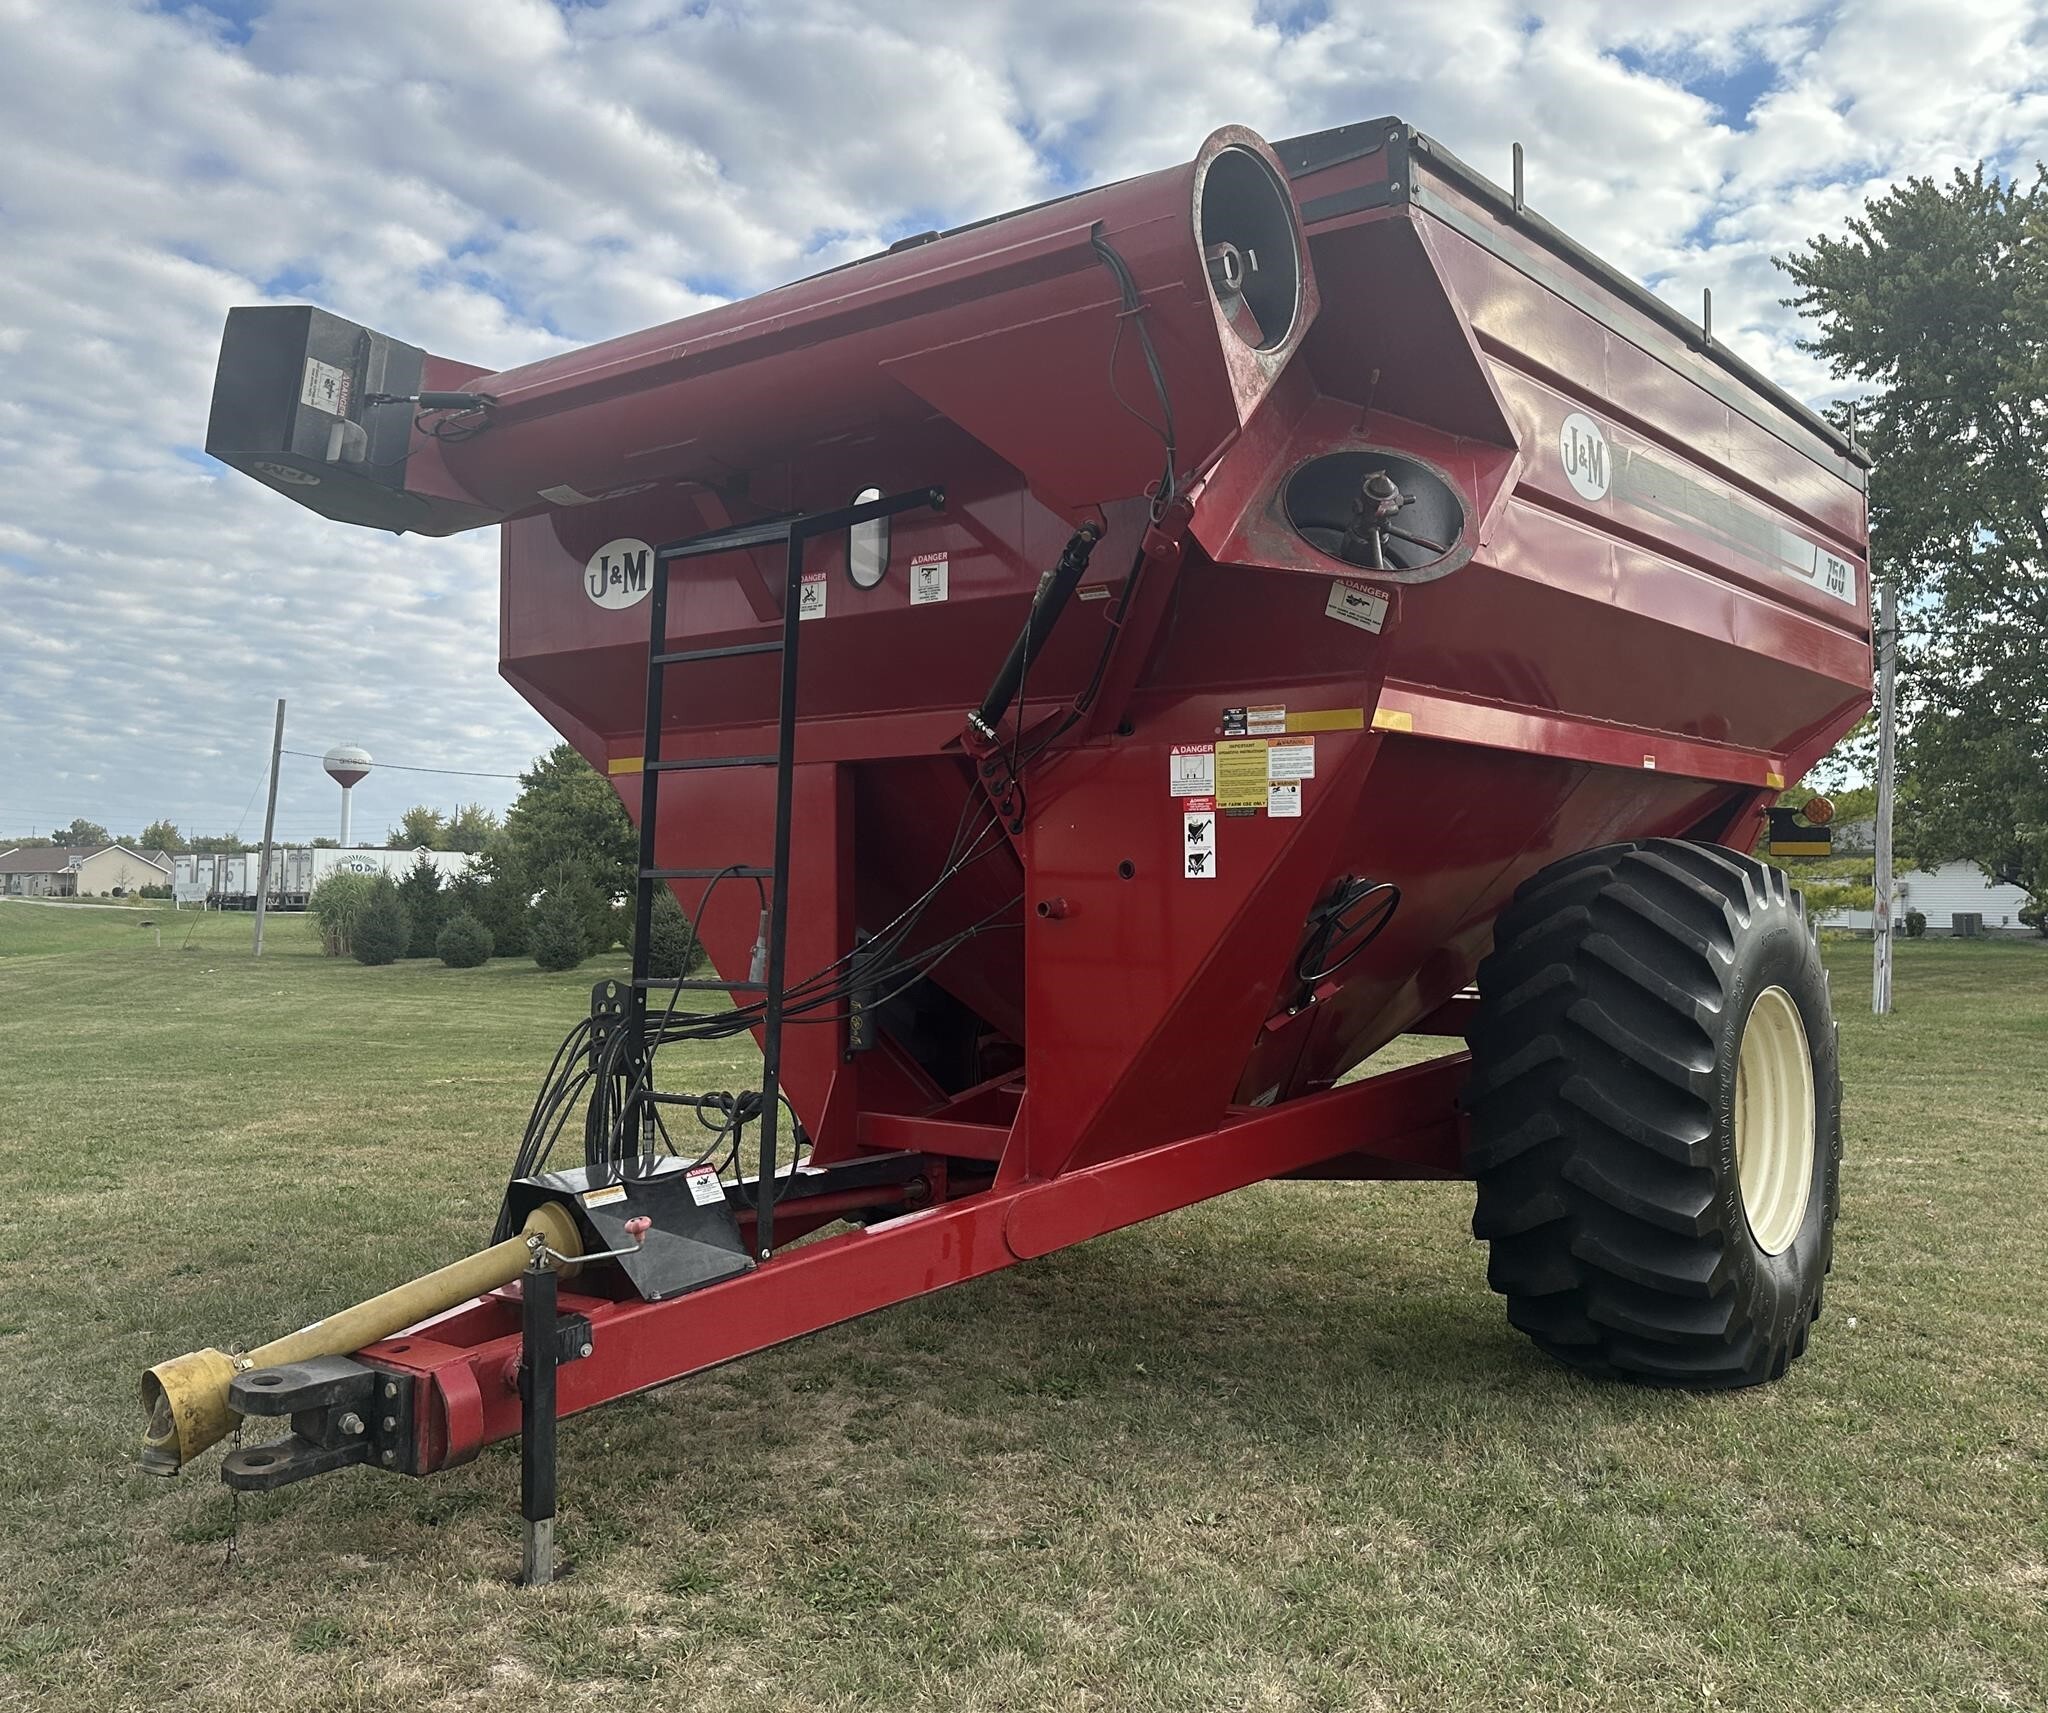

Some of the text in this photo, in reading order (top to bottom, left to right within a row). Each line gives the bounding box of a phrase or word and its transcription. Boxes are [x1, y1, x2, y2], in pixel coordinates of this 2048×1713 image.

[338, 381, 350, 417] DANGER
[1564, 426, 1604, 489] J&M
[589, 550, 648, 599] J&M
[918, 552, 948, 563] DANGER
[1826, 557, 1846, 594] 750
[1346, 580, 1389, 600] DANGER
[1180, 744, 1214, 754] DANGER
